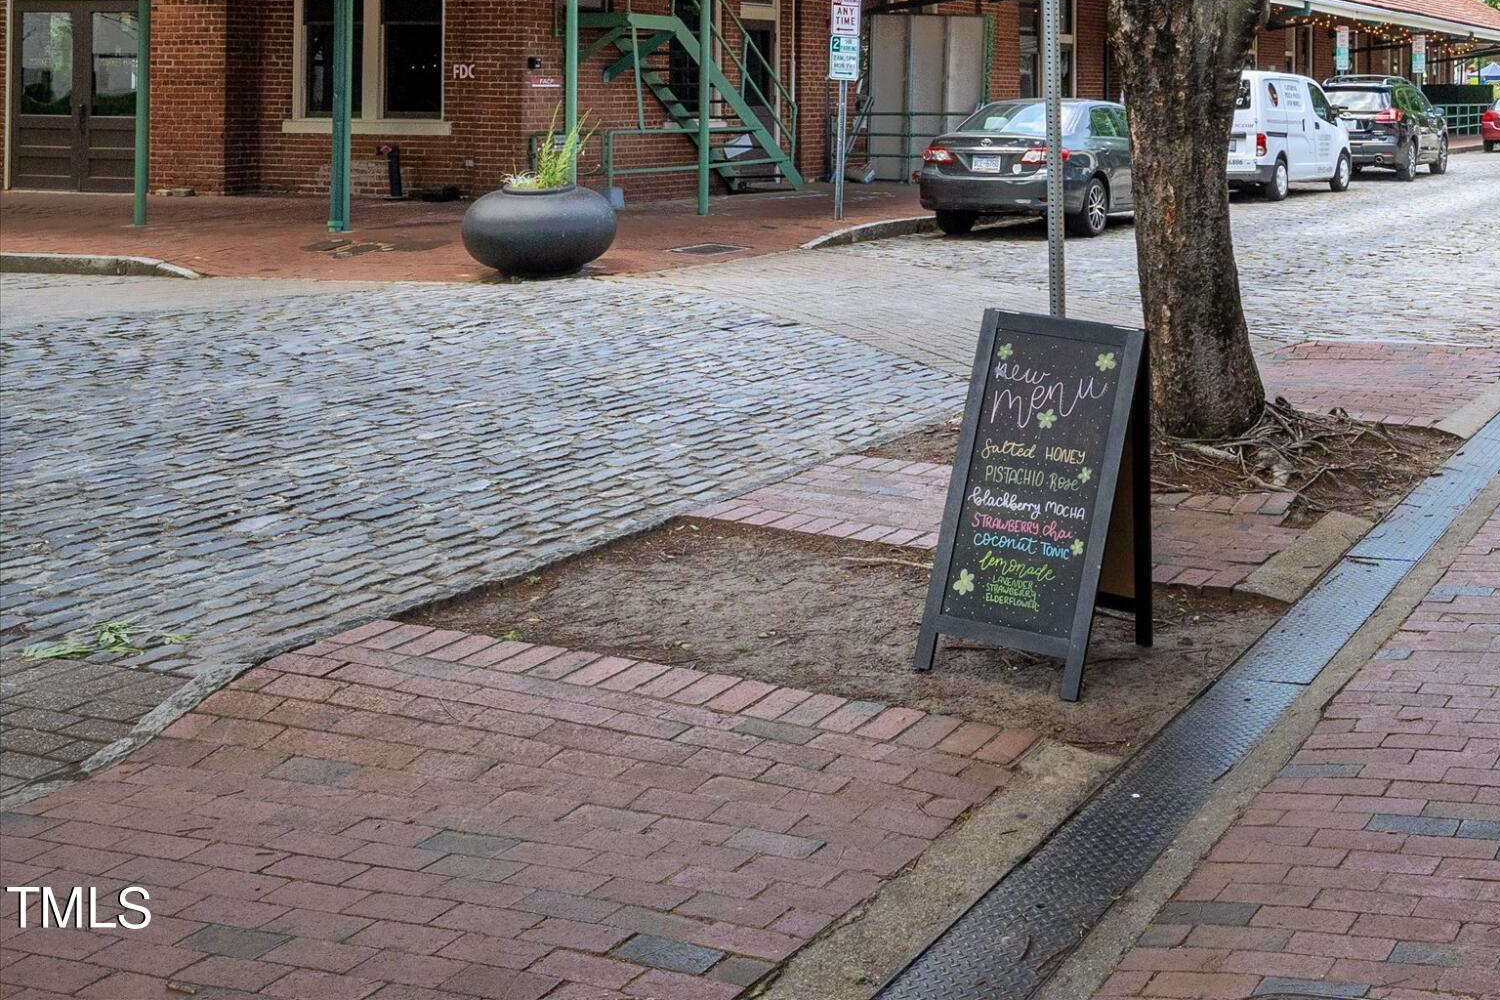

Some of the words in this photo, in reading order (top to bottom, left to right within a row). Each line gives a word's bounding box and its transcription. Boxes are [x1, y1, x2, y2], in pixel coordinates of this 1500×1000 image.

[837, 7, 854, 15] ANY
[836, 17, 855, 25] TIME
[833, 38, 840, 50] 2
[453, 64, 475, 79] FDC
[995, 362, 1050, 384] new
[990, 377, 1108, 428] menu
[1046, 447, 1085, 465] HONEY
[985, 465, 1044, 487] PISTACHIO
[1049, 473, 1080, 492] Rose
[968, 486, 1041, 520] blackberry
[1045, 501, 1086, 520] MOCHA
[971, 512, 1039, 535] STRAWBERRY
[973, 533, 1038, 555] coconut
[1040, 541, 1070, 559] TONIC
[979, 550, 1056, 581] lemonade
[985, 583, 1037, 601] STRAWBERRY
[992, 575, 1034, 591] LAVENDER
[985, 593, 1039, 612] ELDERFLOWER
